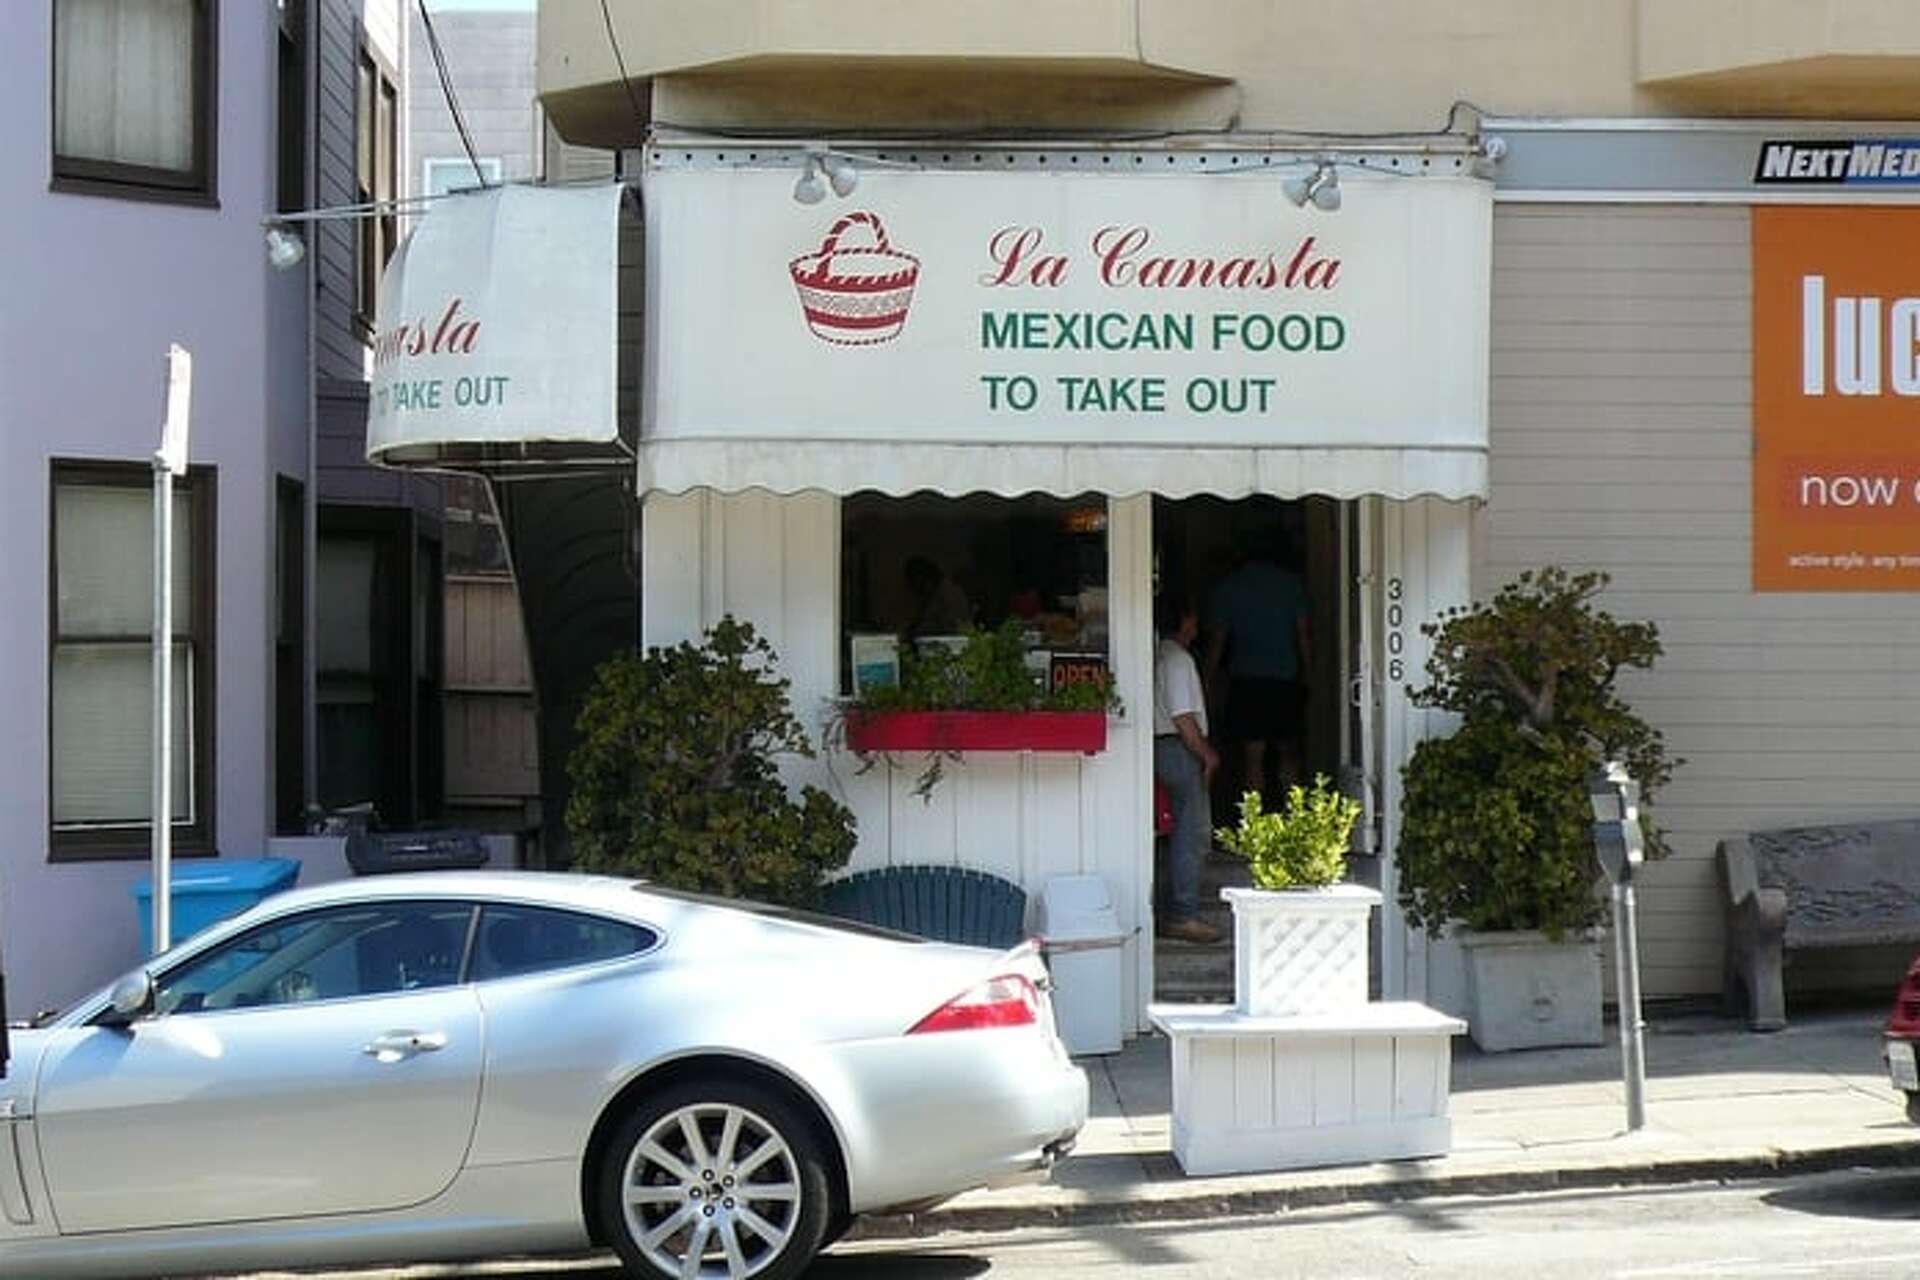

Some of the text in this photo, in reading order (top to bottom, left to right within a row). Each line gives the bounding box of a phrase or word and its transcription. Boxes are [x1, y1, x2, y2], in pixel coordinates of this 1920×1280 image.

[979, 225, 1343, 290] La Canasta
[981, 312, 1346, 352] MEXICAN FOOD
[455, 376, 510, 407] OUT
[980, 376, 1277, 413] TO TAKE OUT
[1801, 476, 1899, 506] now
[1388, 578, 1404, 681] 3006
